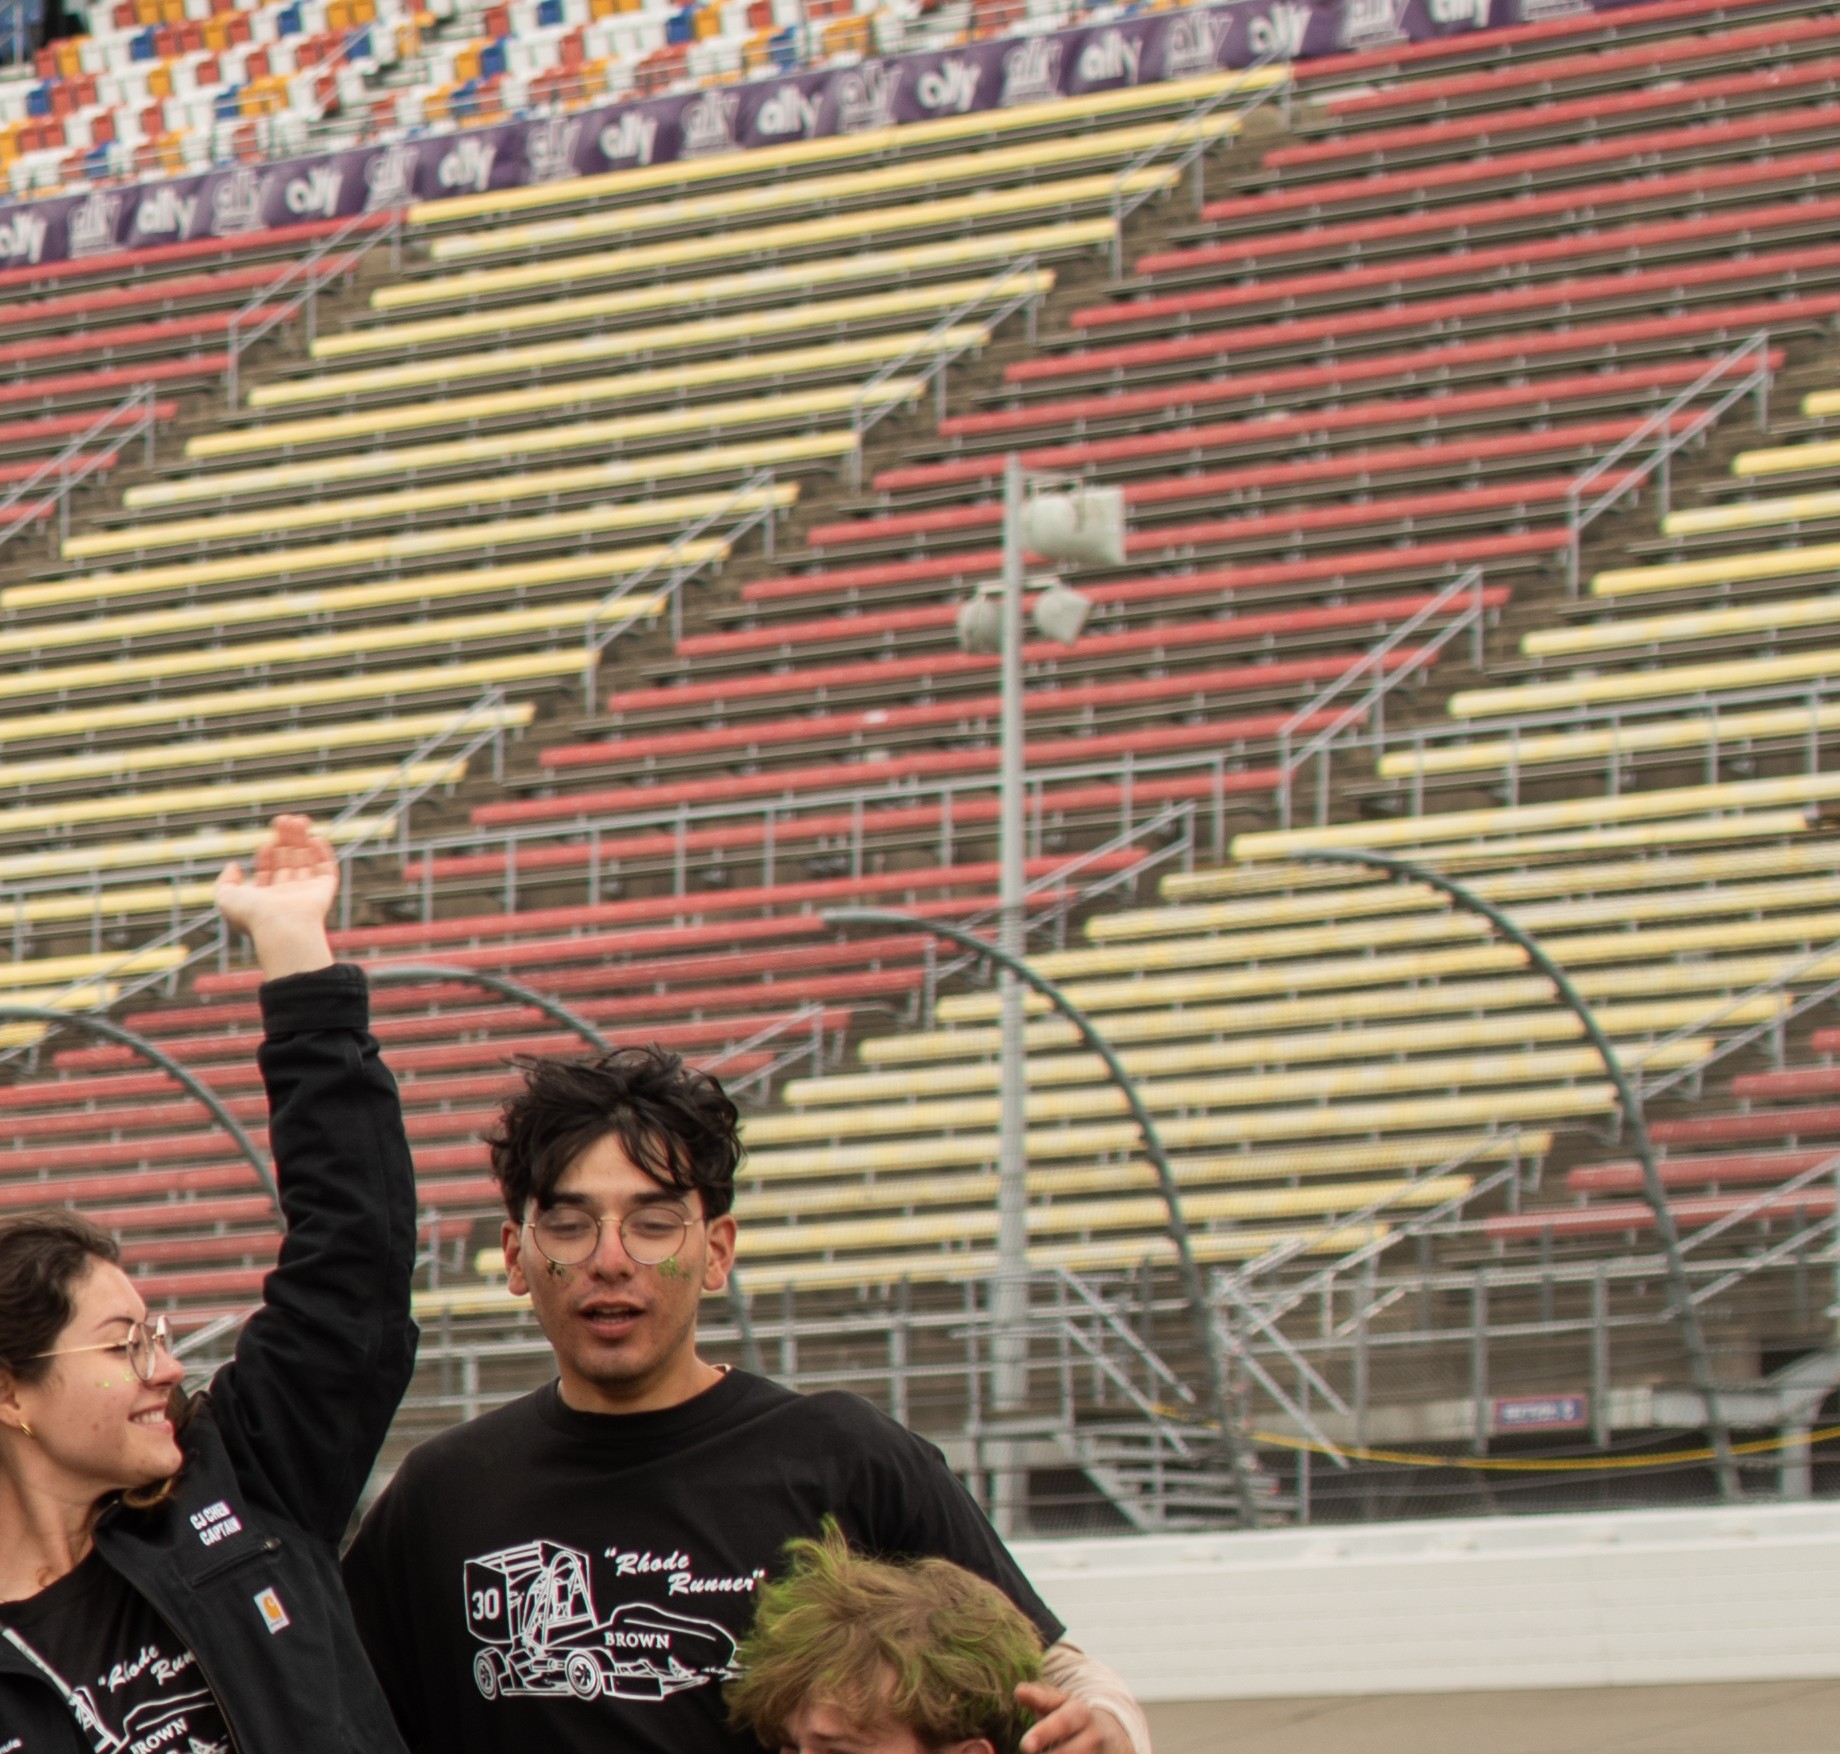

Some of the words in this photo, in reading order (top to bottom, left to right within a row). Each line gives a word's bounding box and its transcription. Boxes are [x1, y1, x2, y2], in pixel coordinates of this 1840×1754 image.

[1080, 31, 1142, 80] ally
[1248, 5, 1312, 57] ally
[918, 60, 981, 112] ally
[758, 86, 822, 138] ally
[438, 139, 496, 191] ally
[601, 115, 658, 166] ally
[137, 187, 198, 238] ally
[286, 168, 345, 218] ally
[199, 1515, 242, 1547] CAPTAIN
[604, 1546, 690, 1577] "Rhode
[668, 1568, 765, 1597] Runner"
[472, 1588, 500, 1621] 30
[604, 1631, 670, 1649] BROWN
[150, 1650, 196, 1686] Run
